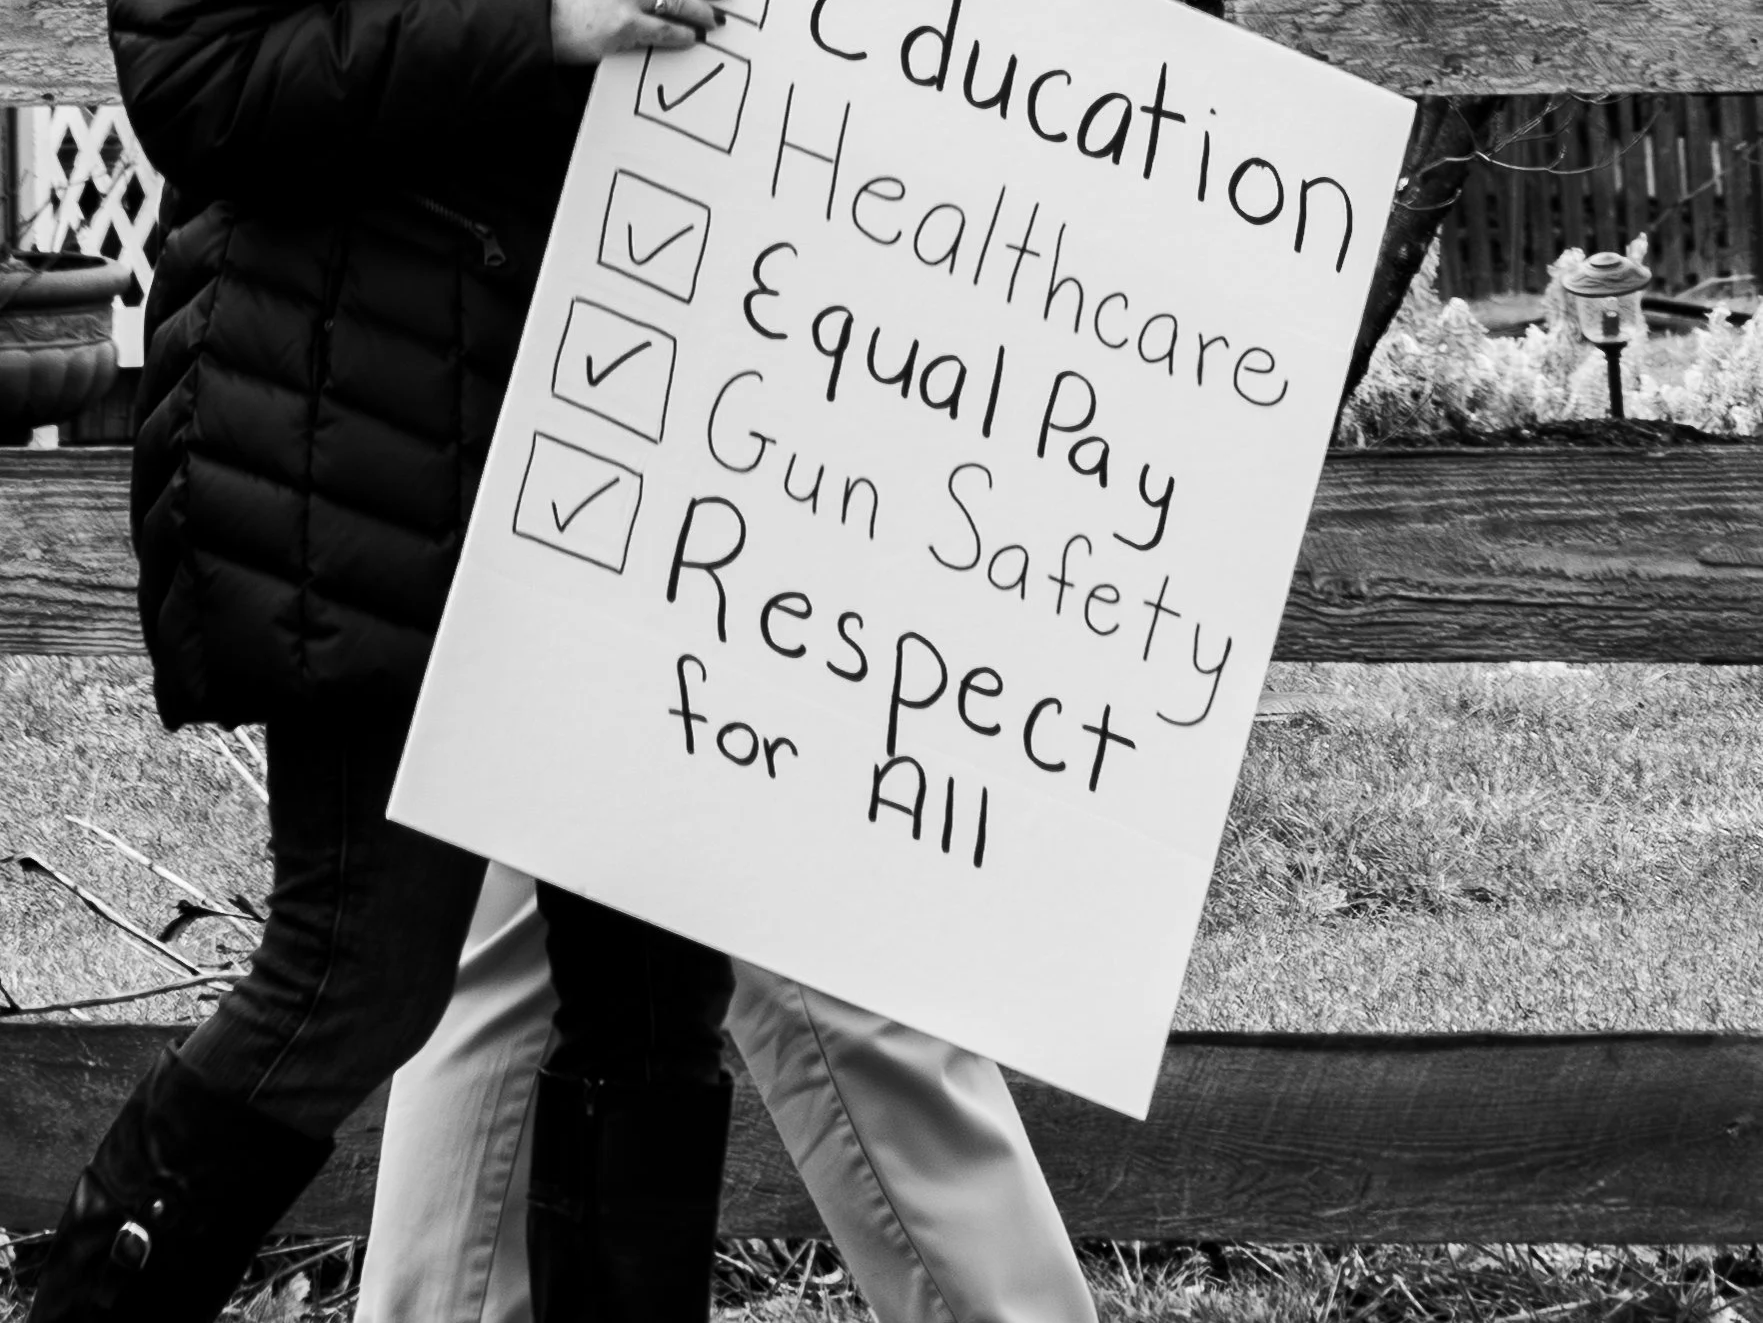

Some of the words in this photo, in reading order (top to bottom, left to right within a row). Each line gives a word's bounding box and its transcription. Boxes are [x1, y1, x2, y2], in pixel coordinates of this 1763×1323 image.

[743, 240, 1005, 439] Equal
[1036, 370, 1176, 552] Pay
[771, 83, 1289, 408] Healthcare
[666, 496, 1138, 794] Respect
[707, 370, 879, 541] Gun
[928, 462, 1234, 728] Safety
[668, 653, 799, 780] for
[867, 758, 988, 870] All
